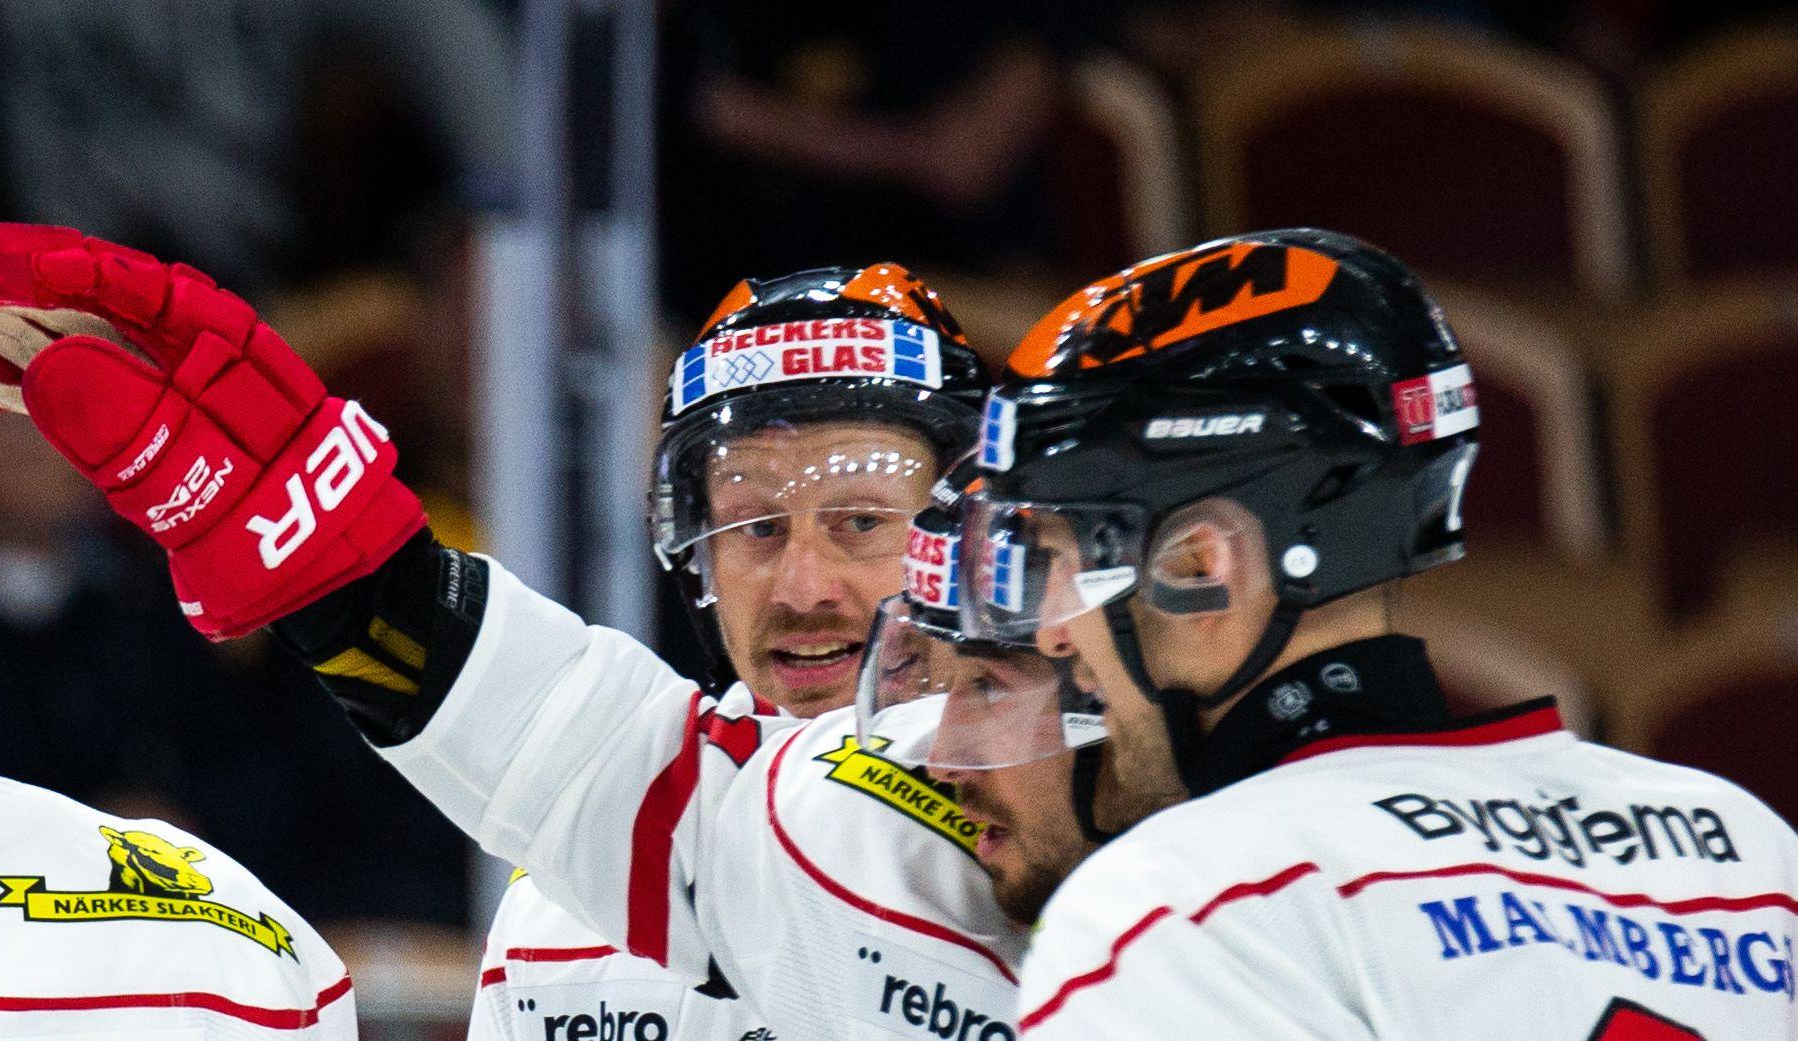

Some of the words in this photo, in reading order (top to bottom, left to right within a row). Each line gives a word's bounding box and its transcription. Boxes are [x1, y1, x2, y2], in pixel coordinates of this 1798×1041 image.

[782, 346, 886, 375] GLAS
[1145, 413, 1266, 439] BAUER
[861, 766, 942, 816] NÄRKE
[53, 895, 151, 917] NÄRKES
[156, 899, 258, 937] SLAKTERI
